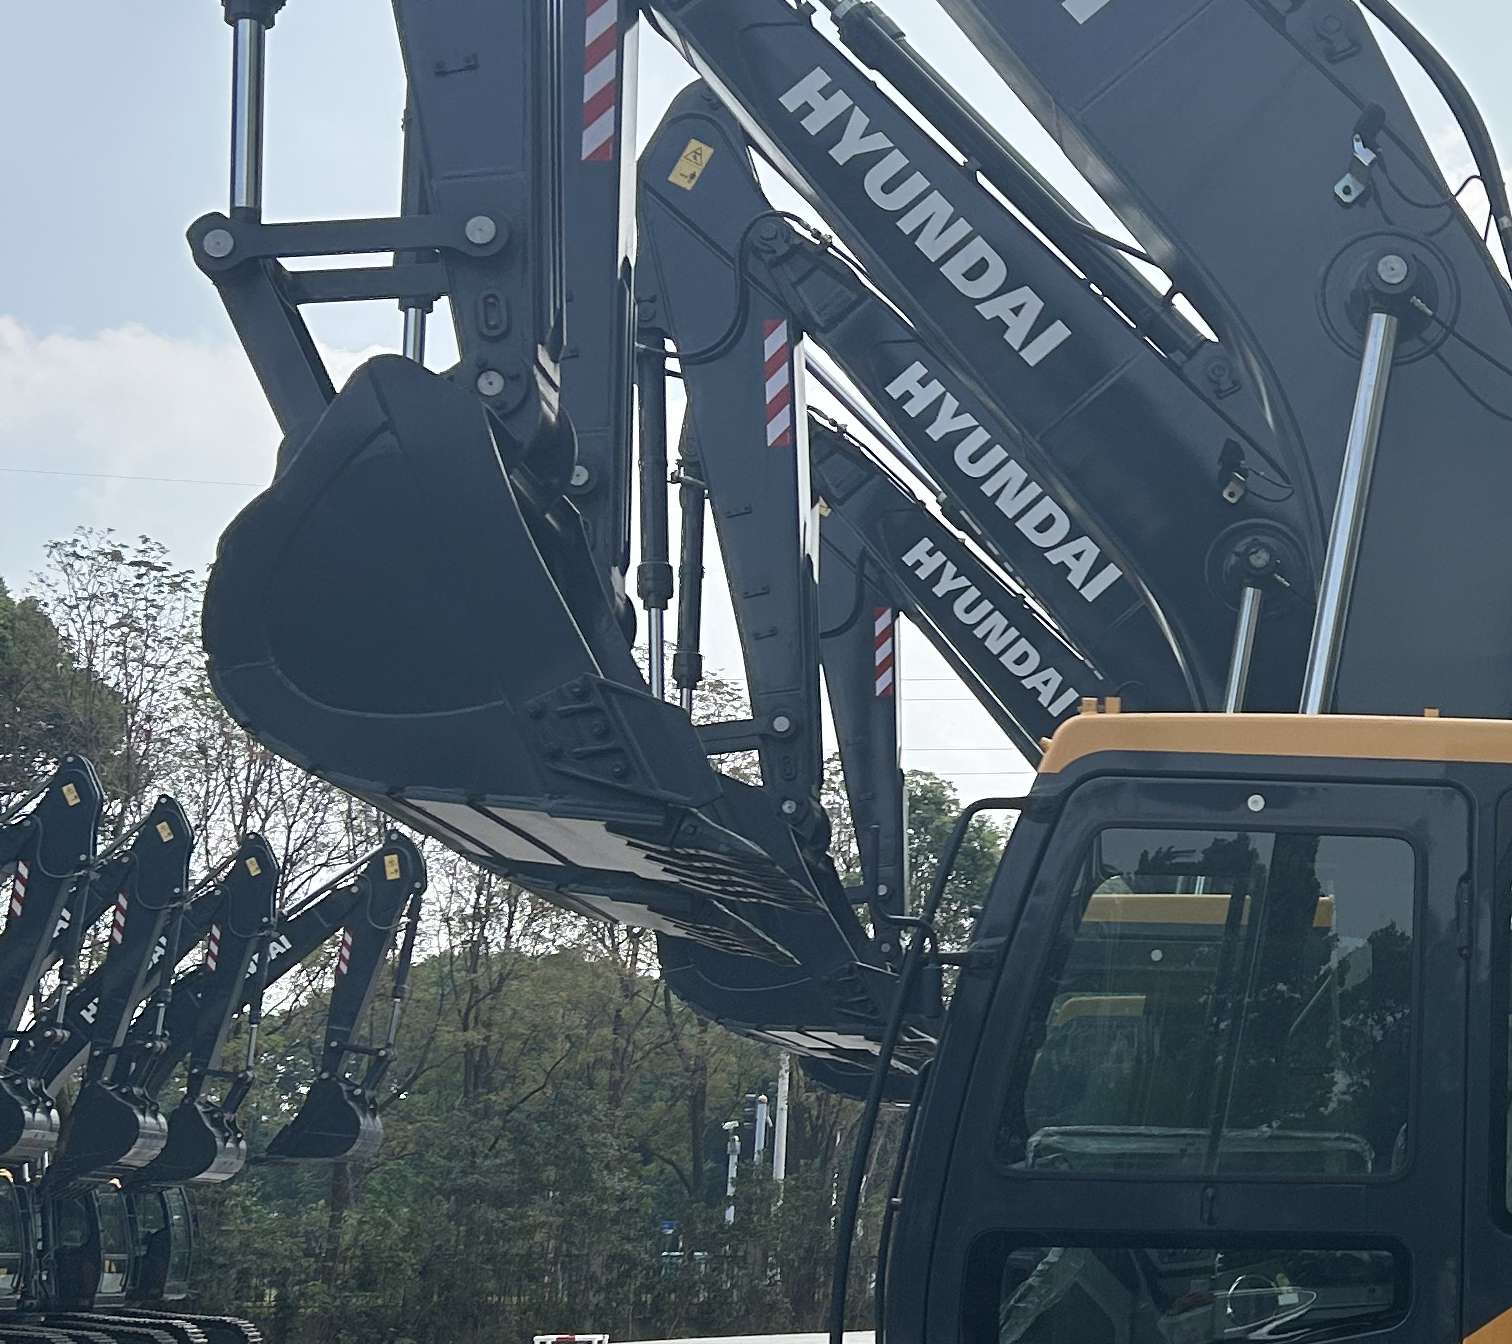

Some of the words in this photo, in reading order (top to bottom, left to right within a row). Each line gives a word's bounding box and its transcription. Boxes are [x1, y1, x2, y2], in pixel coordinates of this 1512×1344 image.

[779, 67, 1071, 366] HYUNDAI
[885, 361, 1122, 602] HYUNDAI
[902, 538, 1079, 717] HYUNDAI
